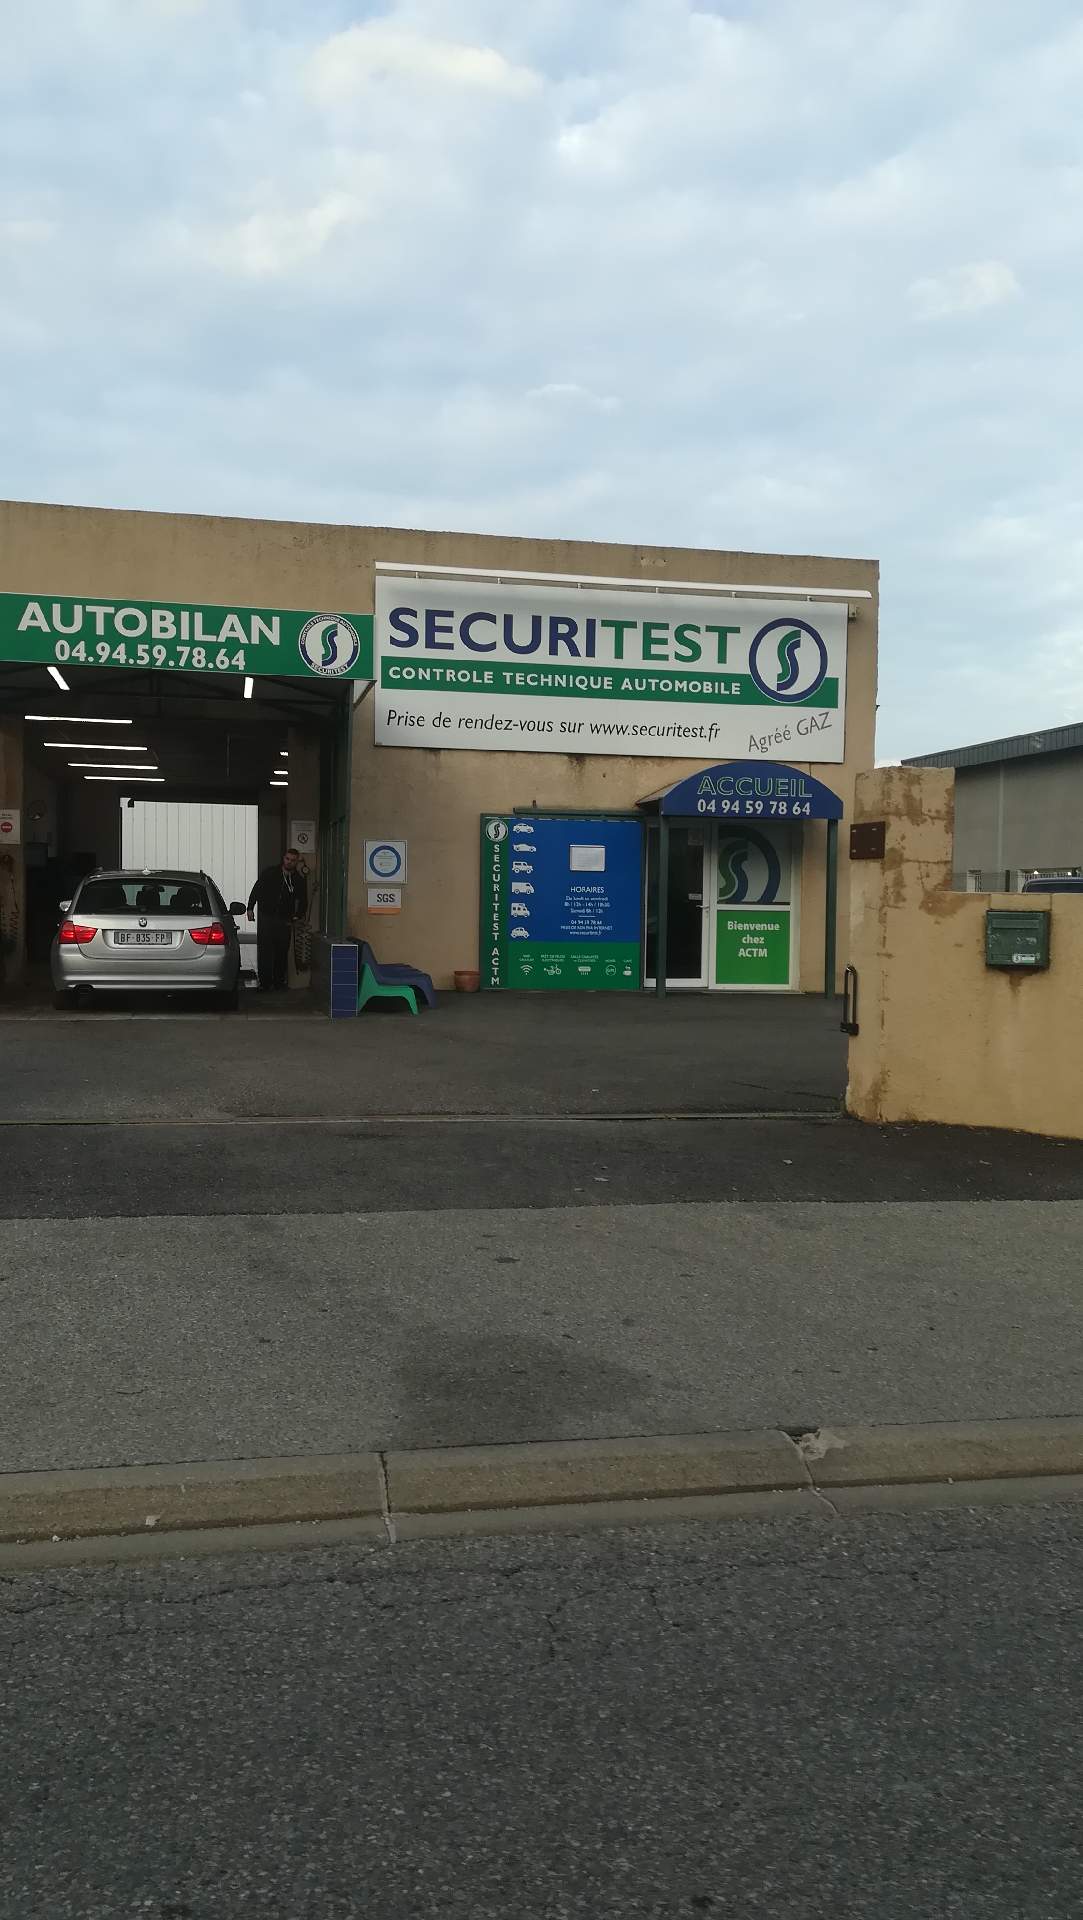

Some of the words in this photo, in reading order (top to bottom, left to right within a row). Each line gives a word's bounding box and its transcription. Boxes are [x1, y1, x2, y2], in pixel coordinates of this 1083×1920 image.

[17, 602, 280, 646] AUTOBILAN
[388, 607, 741, 665] SECURITEST
[55, 639, 246, 671] 04.94.59.78.64
[388, 666, 494, 684] CONTROLE
[502, 672, 613, 691] TECHNIQUE
[621, 678, 741, 695] AUTOMOBILE
[386, 709, 426, 728] Prise
[432, 712, 452, 728] de
[458, 714, 554, 733] rendez-vous
[559, 720, 585, 734] sur
[590, 722, 721, 743] www.securitest.fr
[748, 725, 793, 754] Agréé
[796, 711, 833, 736] GAZ
[697, 776, 813, 798] ACCUEIL
[697, 799, 717, 814] 04
[721, 799, 741, 815] 94
[745, 800, 764, 815] 59
[769, 801, 788, 816] 78
[792, 802, 812, 816] 64
[376, 893, 396, 903] SGS
[727, 921, 780, 931] Bienvenue
[742, 934, 765, 944] chez
[738, 948, 768, 958] ACTM
